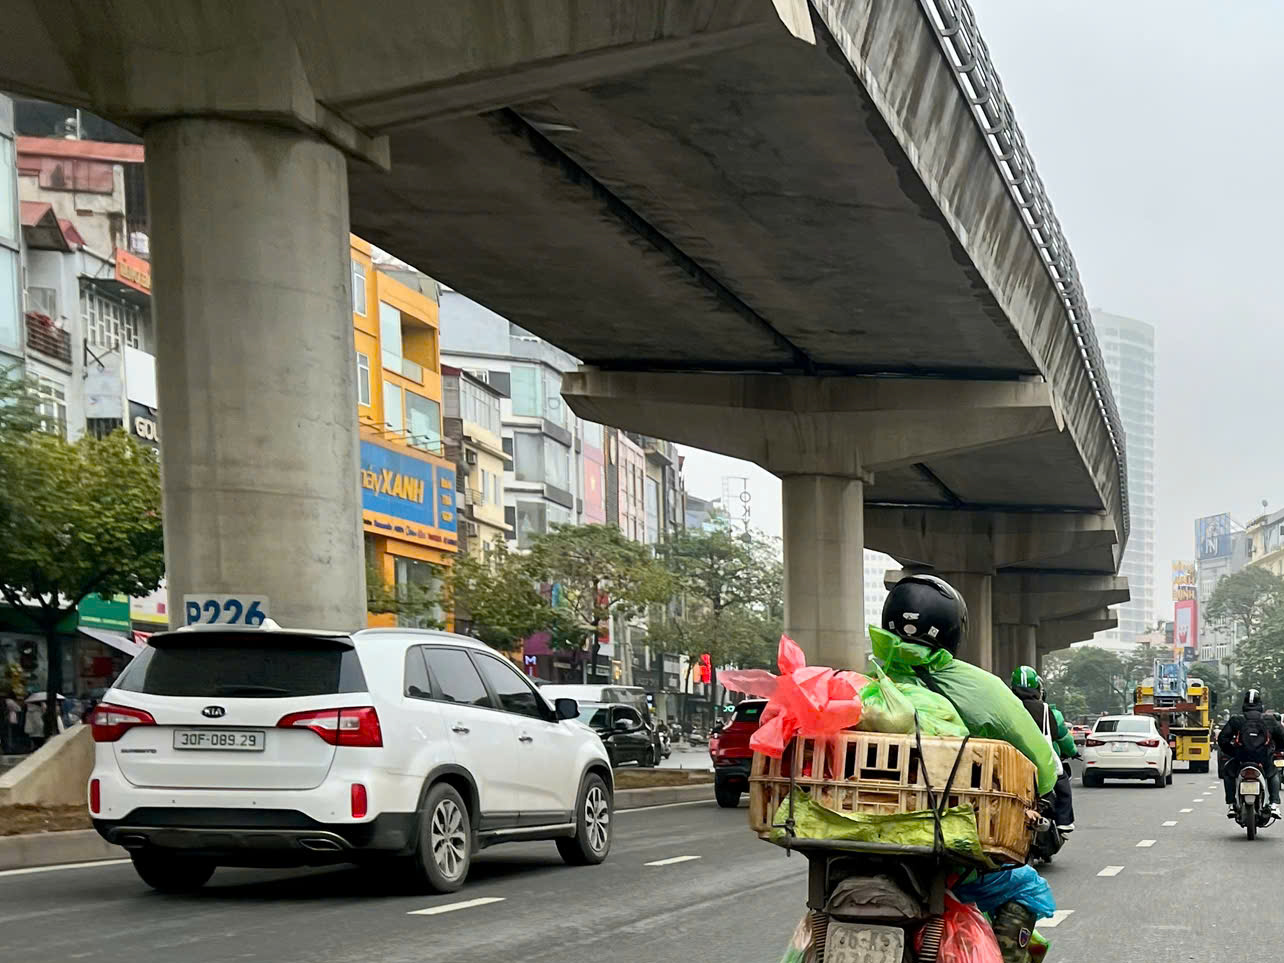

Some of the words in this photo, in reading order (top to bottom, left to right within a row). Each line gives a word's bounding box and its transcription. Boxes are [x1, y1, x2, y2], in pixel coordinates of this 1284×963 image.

[382, 467, 425, 504] XANH
[186, 598, 266, 626] P226
[204, 707, 223, 717] KIA
